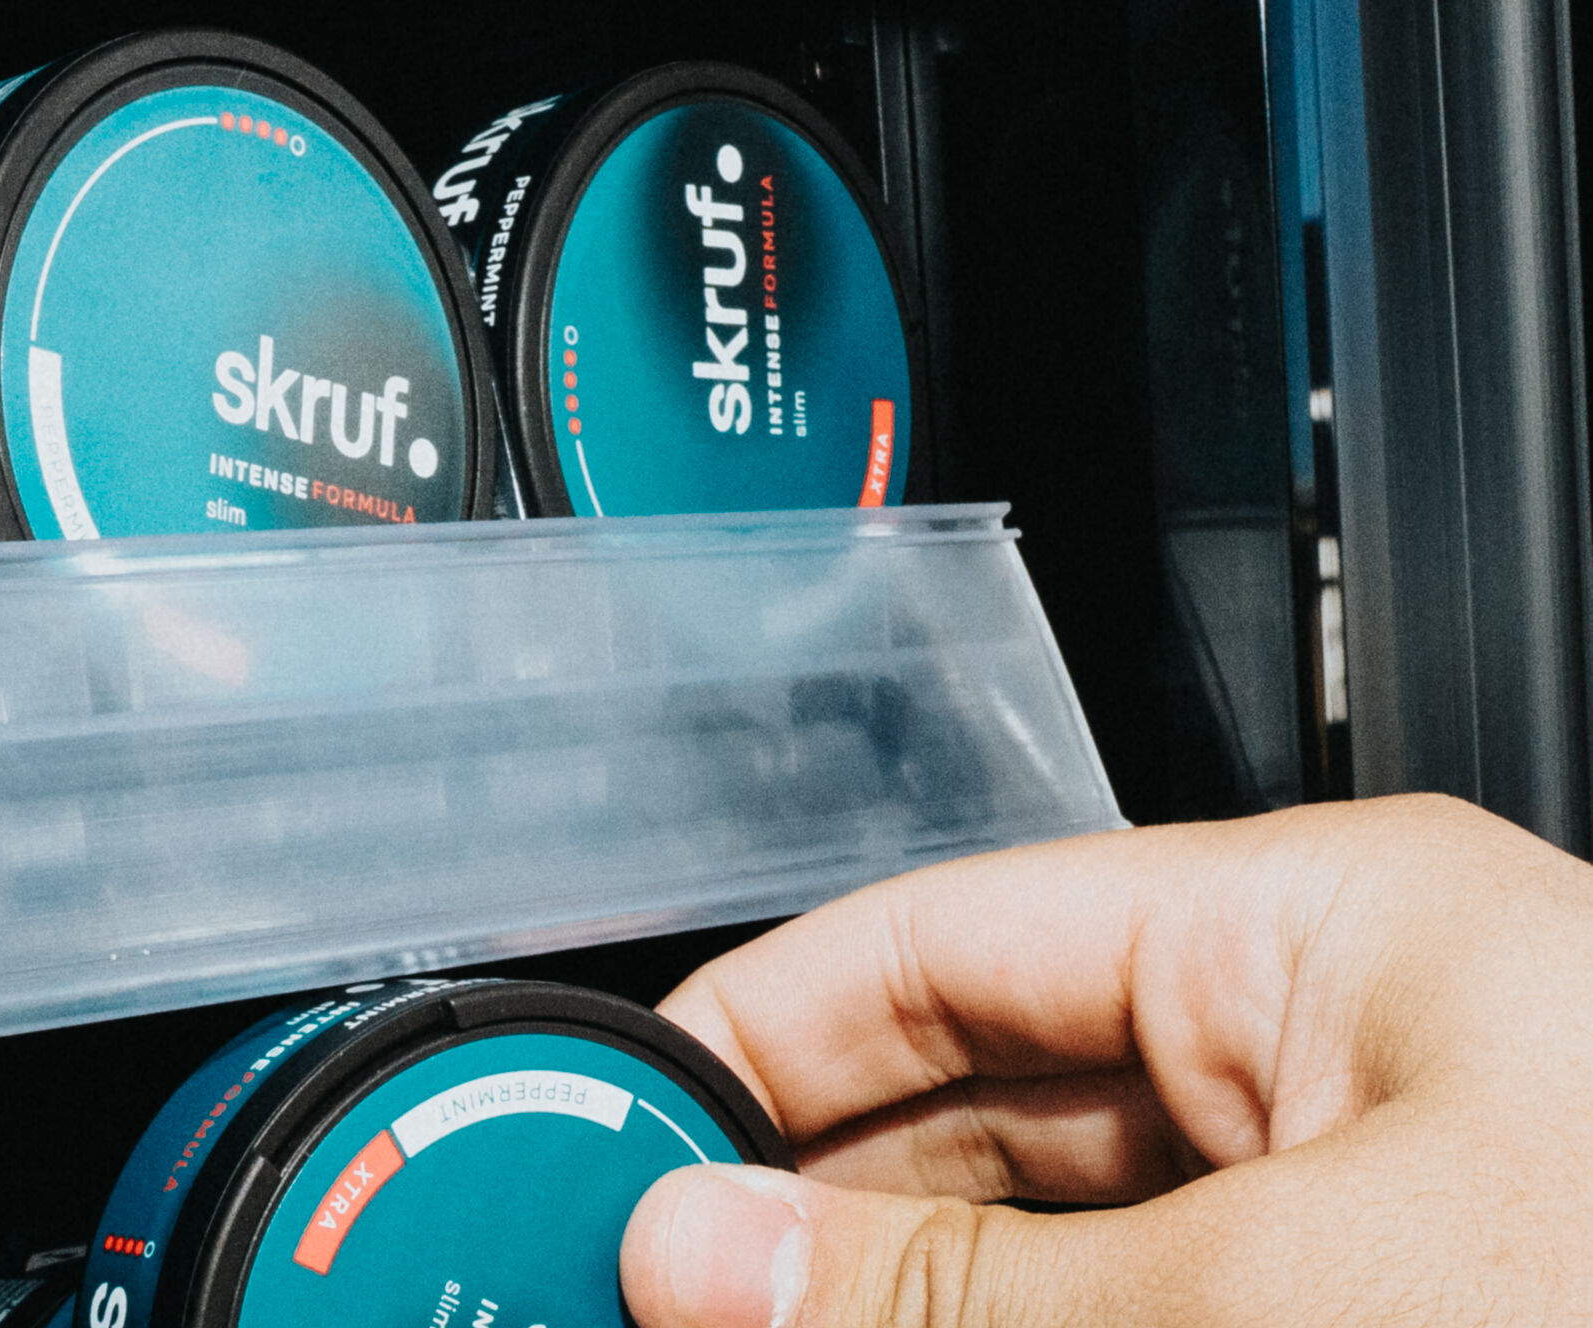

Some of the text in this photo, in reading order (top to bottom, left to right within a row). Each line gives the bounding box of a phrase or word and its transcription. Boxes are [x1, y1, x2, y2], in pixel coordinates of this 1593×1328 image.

[482, 174, 531, 327] PEPPERMINT
[795, 389, 807, 438] slim
[39, 403, 83, 538] PEPPERM
[870, 433, 889, 494] XTRA
[205, 497, 247, 527] slim
[439, 1080, 588, 1125] PEPPERMINT
[318, 1161, 374, 1231] XTRA
